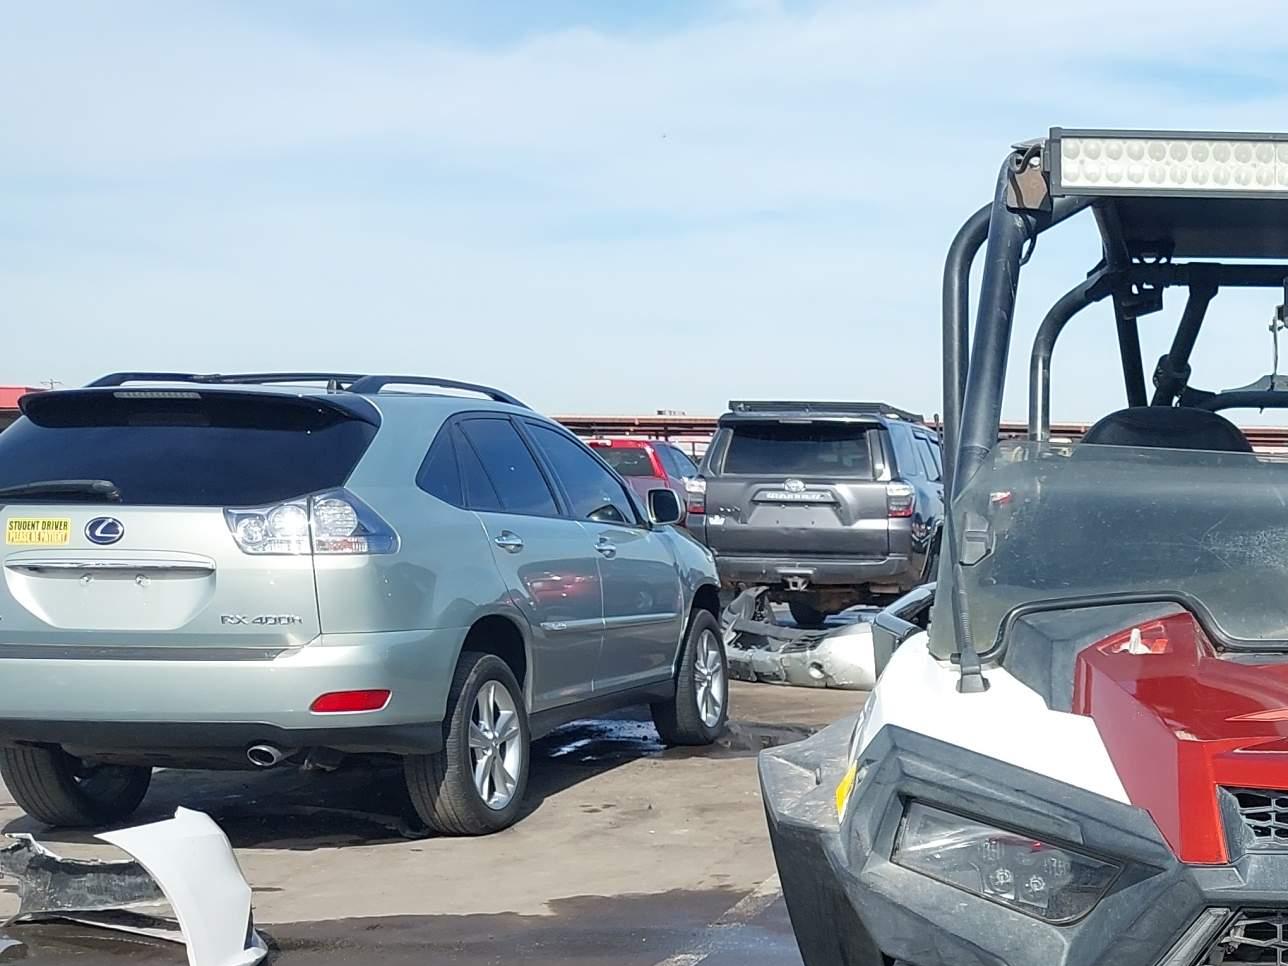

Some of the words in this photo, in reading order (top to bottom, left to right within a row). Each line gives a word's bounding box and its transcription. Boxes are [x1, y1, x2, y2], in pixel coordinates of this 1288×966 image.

[8, 520, 40, 531] STUDENT
[41, 520, 68, 531] DRIVER
[220, 615, 248, 625] RX
